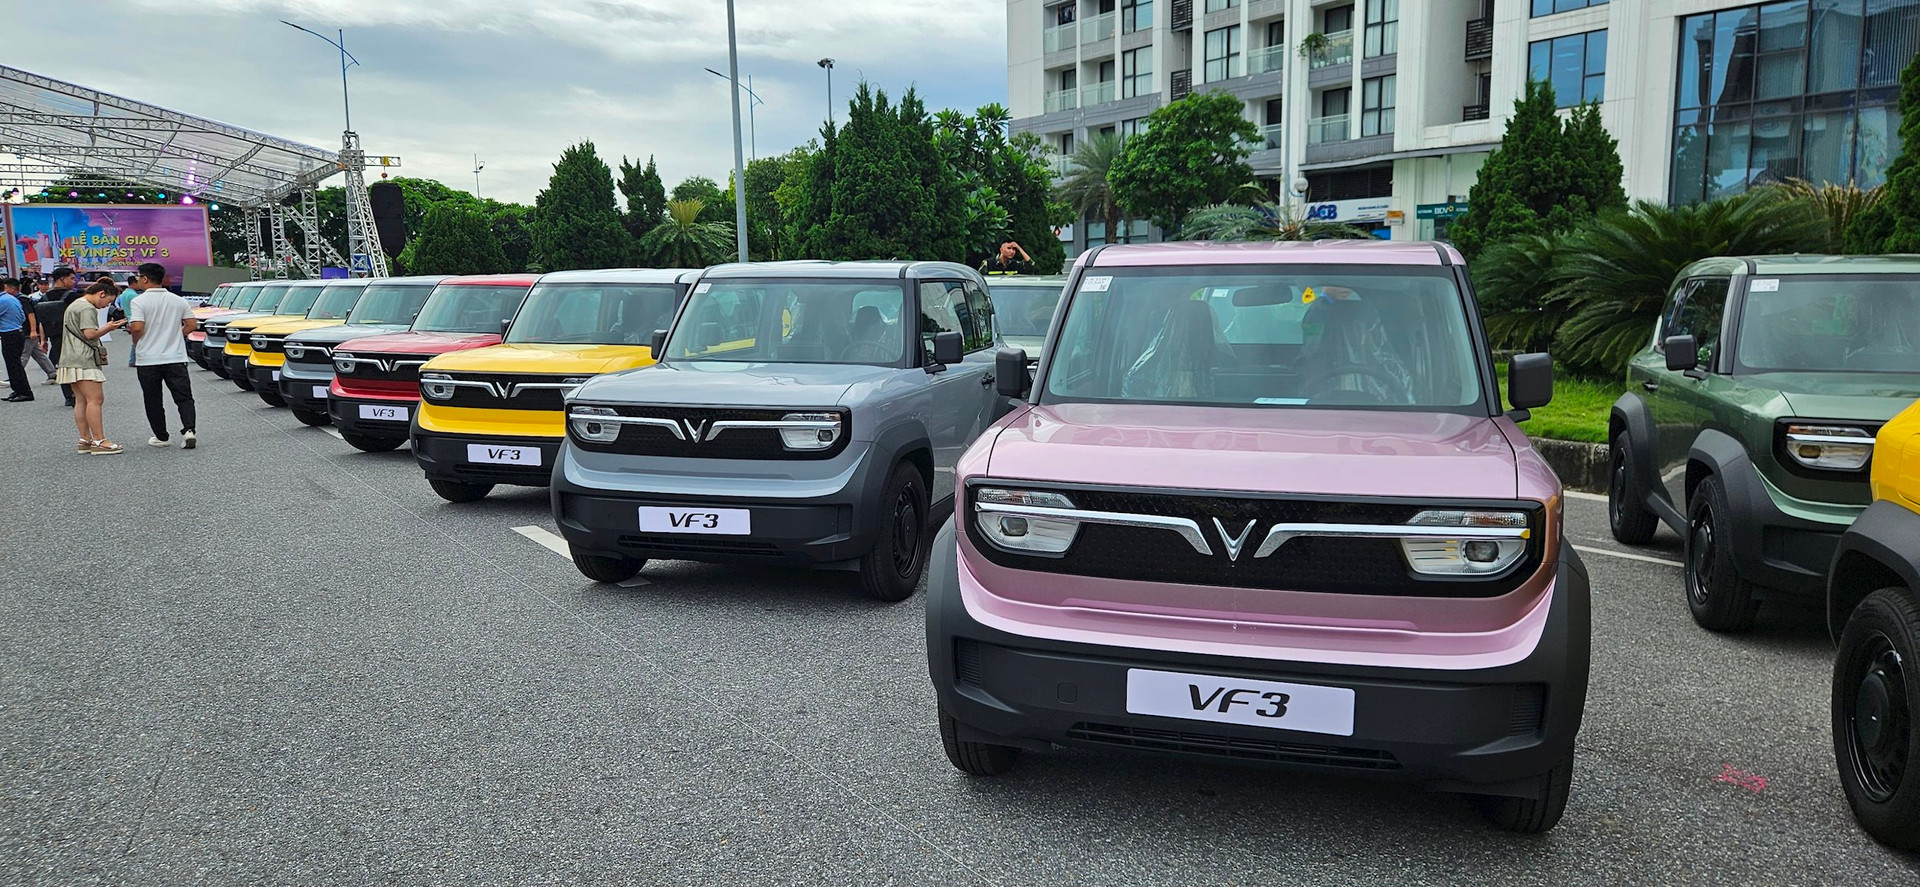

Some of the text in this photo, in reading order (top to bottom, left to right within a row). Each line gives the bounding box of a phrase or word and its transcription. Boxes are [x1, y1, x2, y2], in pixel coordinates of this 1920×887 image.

[1306, 204, 1337, 220] ACB
[125, 235, 159, 245] GIAO
[59, 248, 169, 258] XE VINFAST VF 3
[372, 408, 395, 418] VF3
[487, 448, 520, 461] VF3
[669, 513, 719, 528] VF3
[1188, 684, 1290, 718] VF3
